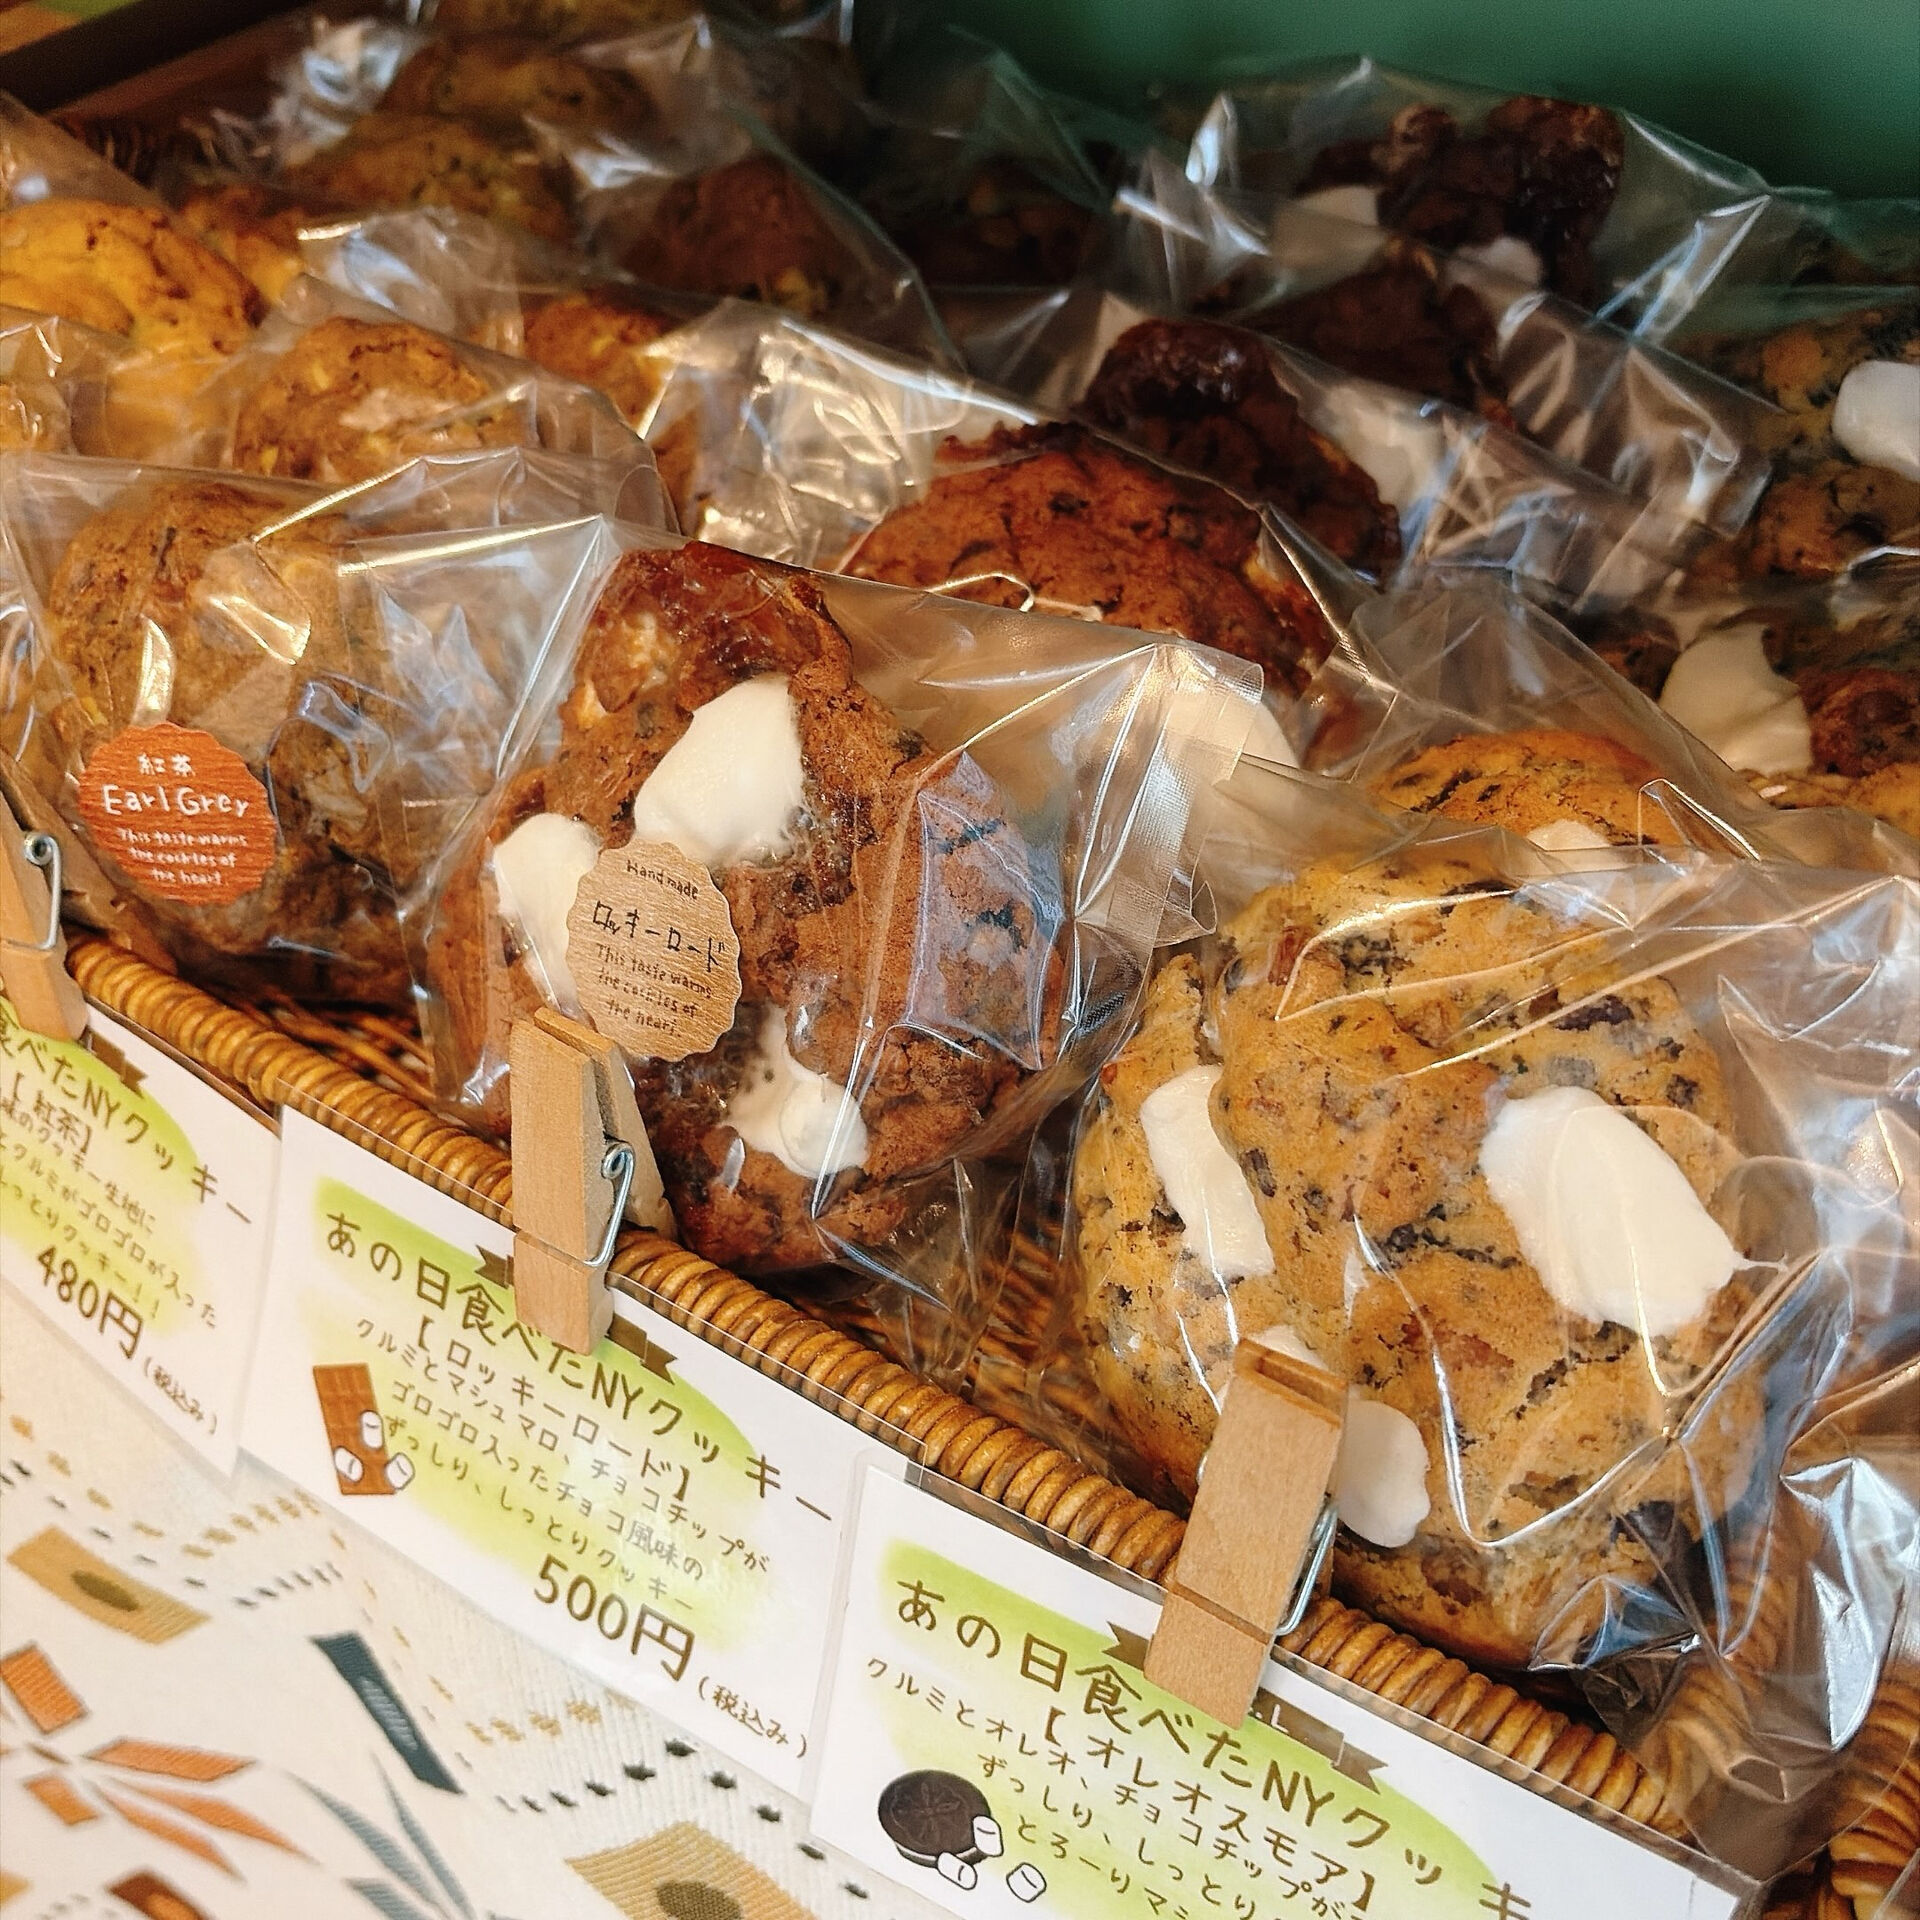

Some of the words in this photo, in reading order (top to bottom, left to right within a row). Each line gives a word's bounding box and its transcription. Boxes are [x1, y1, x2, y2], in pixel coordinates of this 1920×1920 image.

[102, 784, 170, 815] Earl
[176, 786, 249, 818] Grey
[138, 752, 195, 777] 紅茶
[117, 827, 150, 844] This
[592, 901, 726, 973] ロッキーロード
[597, 943, 625, 967] This
[37, 1245, 144, 1360] 480円
[327, 1212, 832, 1522] あの日食べたNYクッキー
[534, 1553, 697, 1683] 500円
[867, 1657, 1366, 1920] クルミとオレオ、チョコチップが
[977, 1753, 1283, 1920] ずっしり、しっとり
